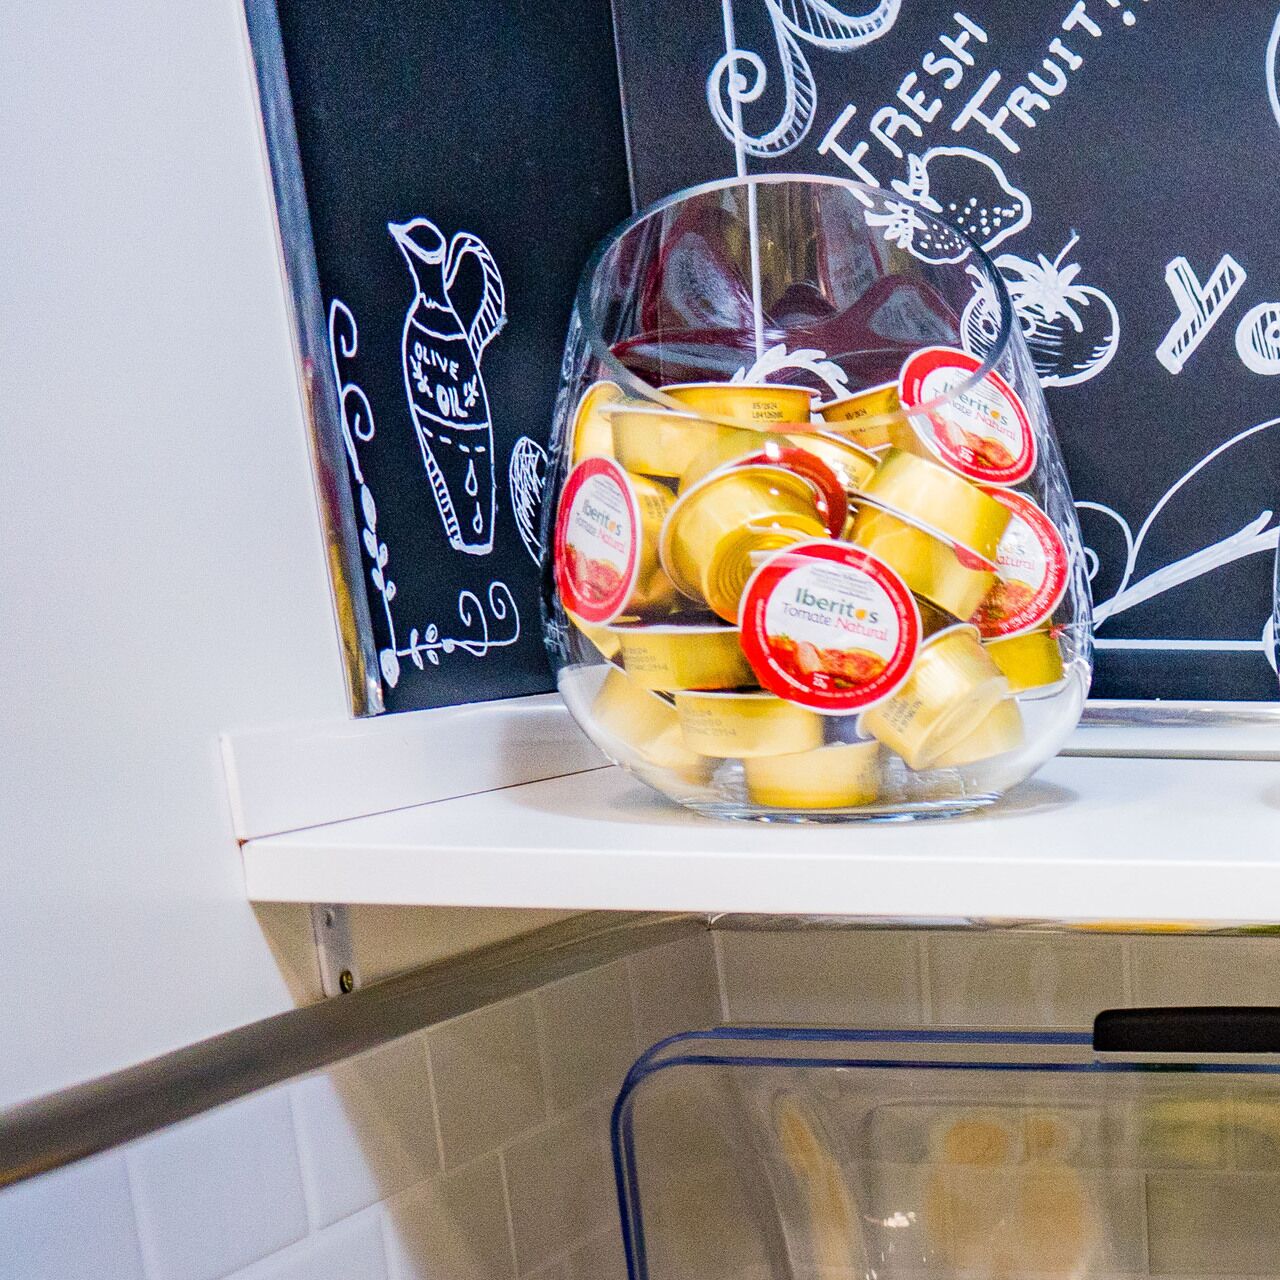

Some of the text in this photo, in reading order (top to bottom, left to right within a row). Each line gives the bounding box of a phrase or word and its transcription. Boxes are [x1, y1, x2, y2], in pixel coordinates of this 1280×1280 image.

[818, 12, 988, 188] FRESH
[414, 341, 459, 381] OLIVE
[436, 384, 468, 417] OIL
[997, 555, 1035, 571] atural
[782, 602, 888, 641] Tomate Natural
[794, 587, 879, 625] Iberitos
